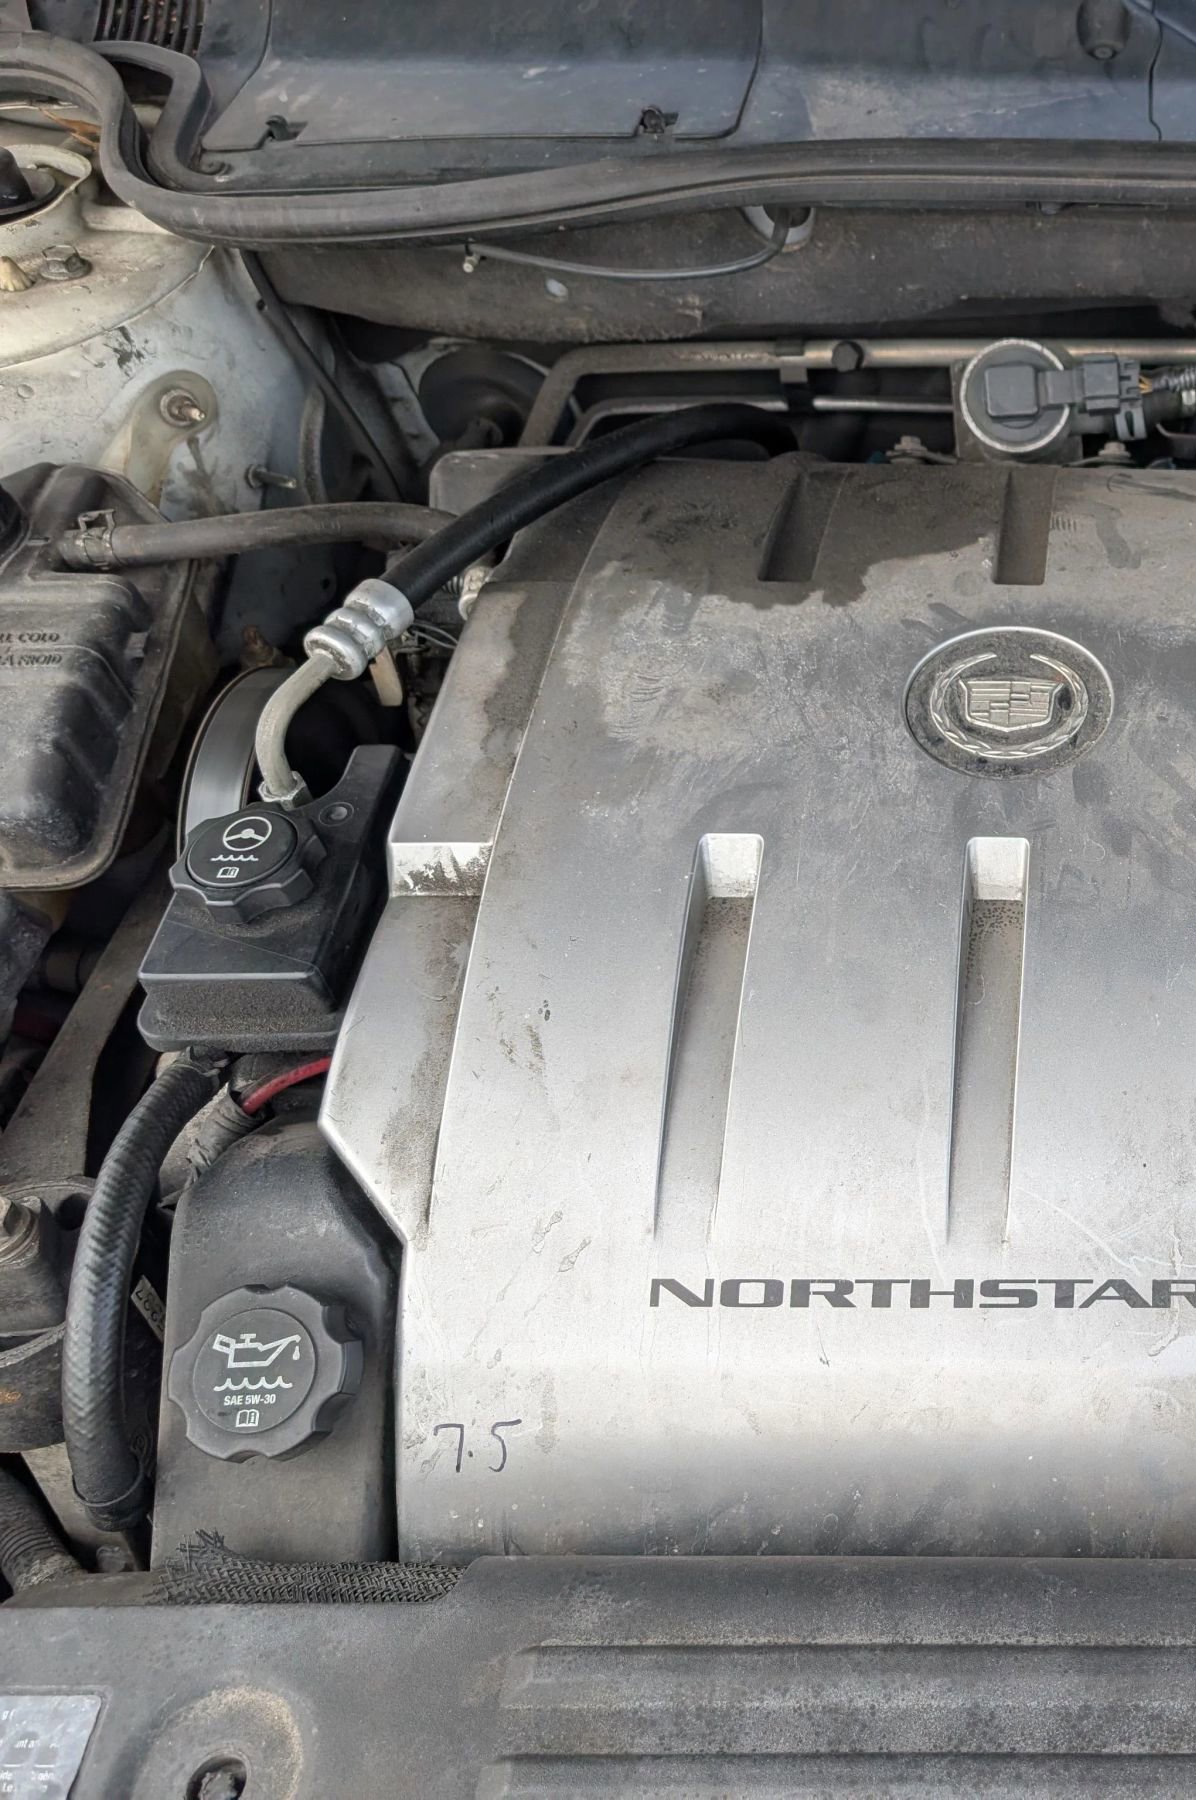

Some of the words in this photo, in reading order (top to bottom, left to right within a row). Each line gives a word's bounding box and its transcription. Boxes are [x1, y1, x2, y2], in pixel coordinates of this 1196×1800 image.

[18, 632, 60, 643] COLD
[223, 1394, 244, 1406] SAE
[244, 1393, 277, 1405] 5W-30
[433, 1418, 523, 1473] 7.5
